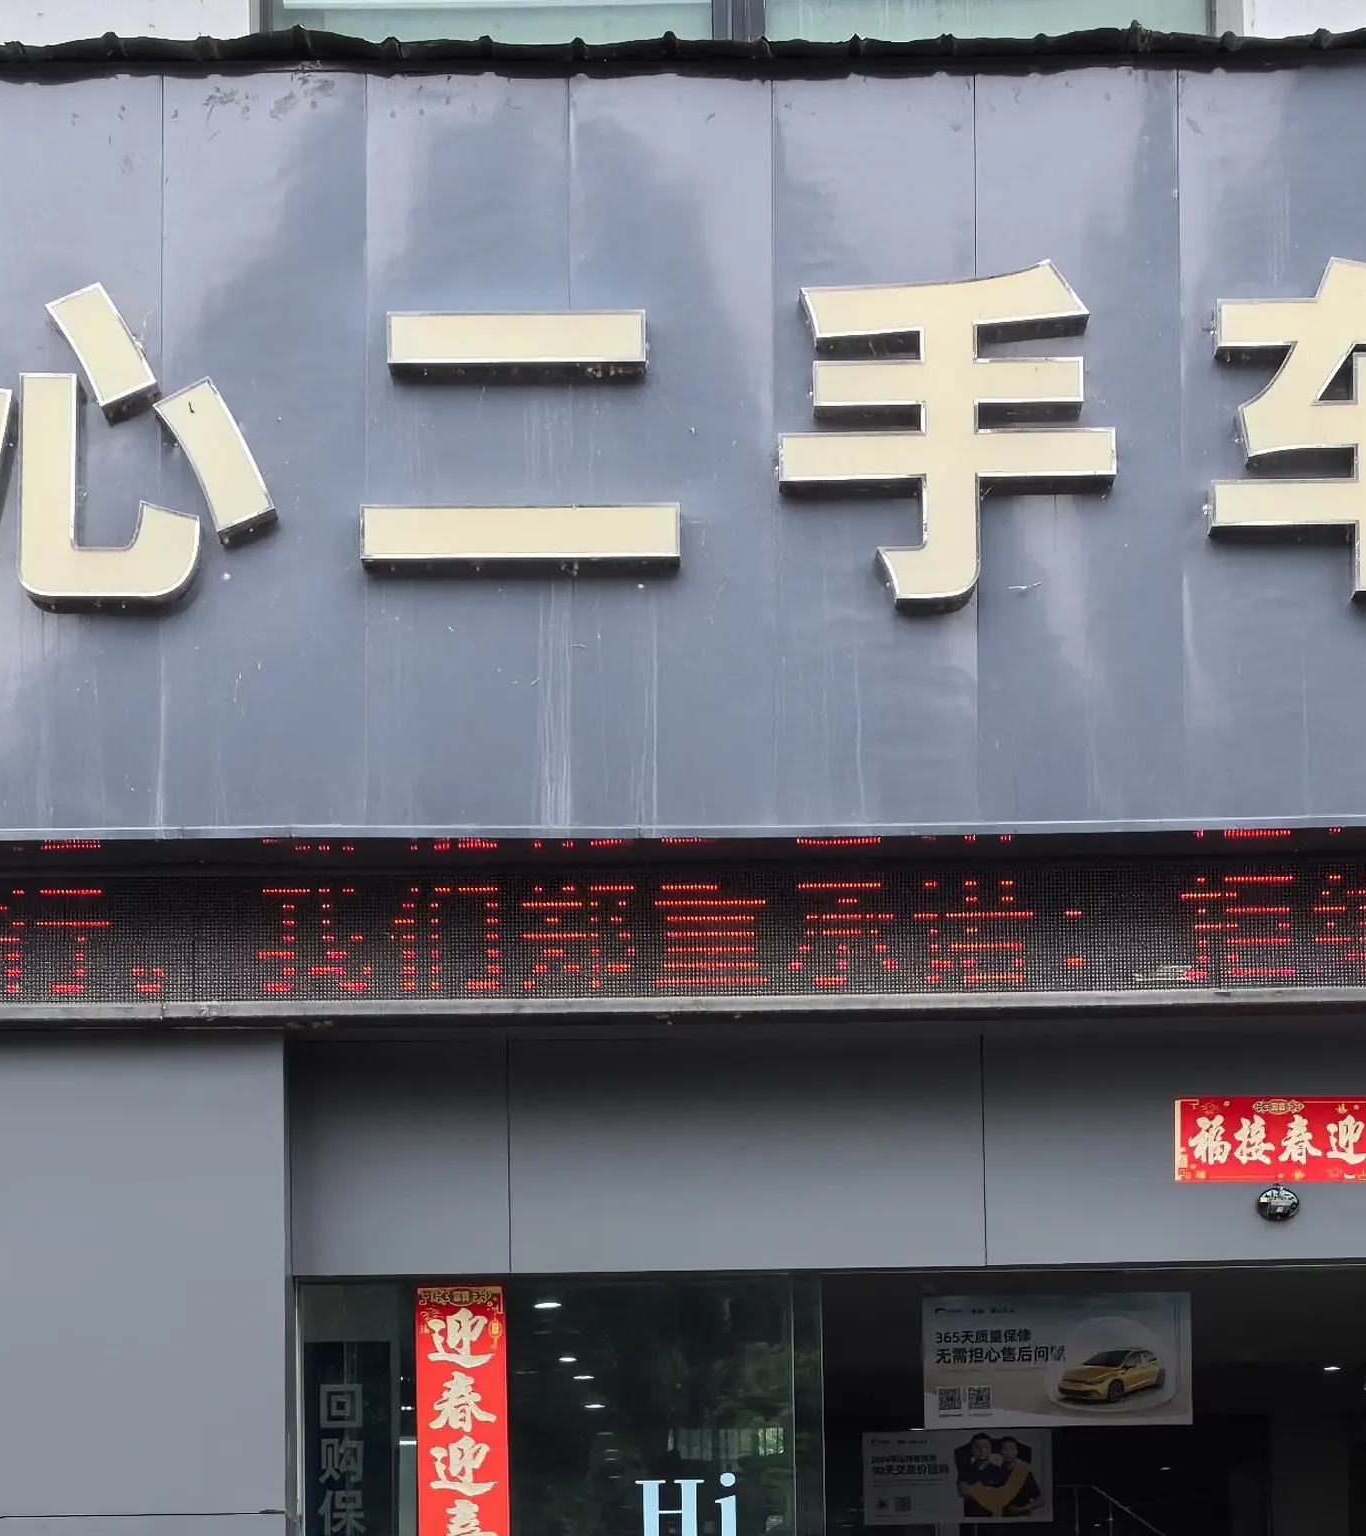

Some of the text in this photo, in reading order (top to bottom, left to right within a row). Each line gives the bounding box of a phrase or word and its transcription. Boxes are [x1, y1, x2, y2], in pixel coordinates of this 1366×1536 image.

[936, 1328, 1032, 1344] 365天质量保修
